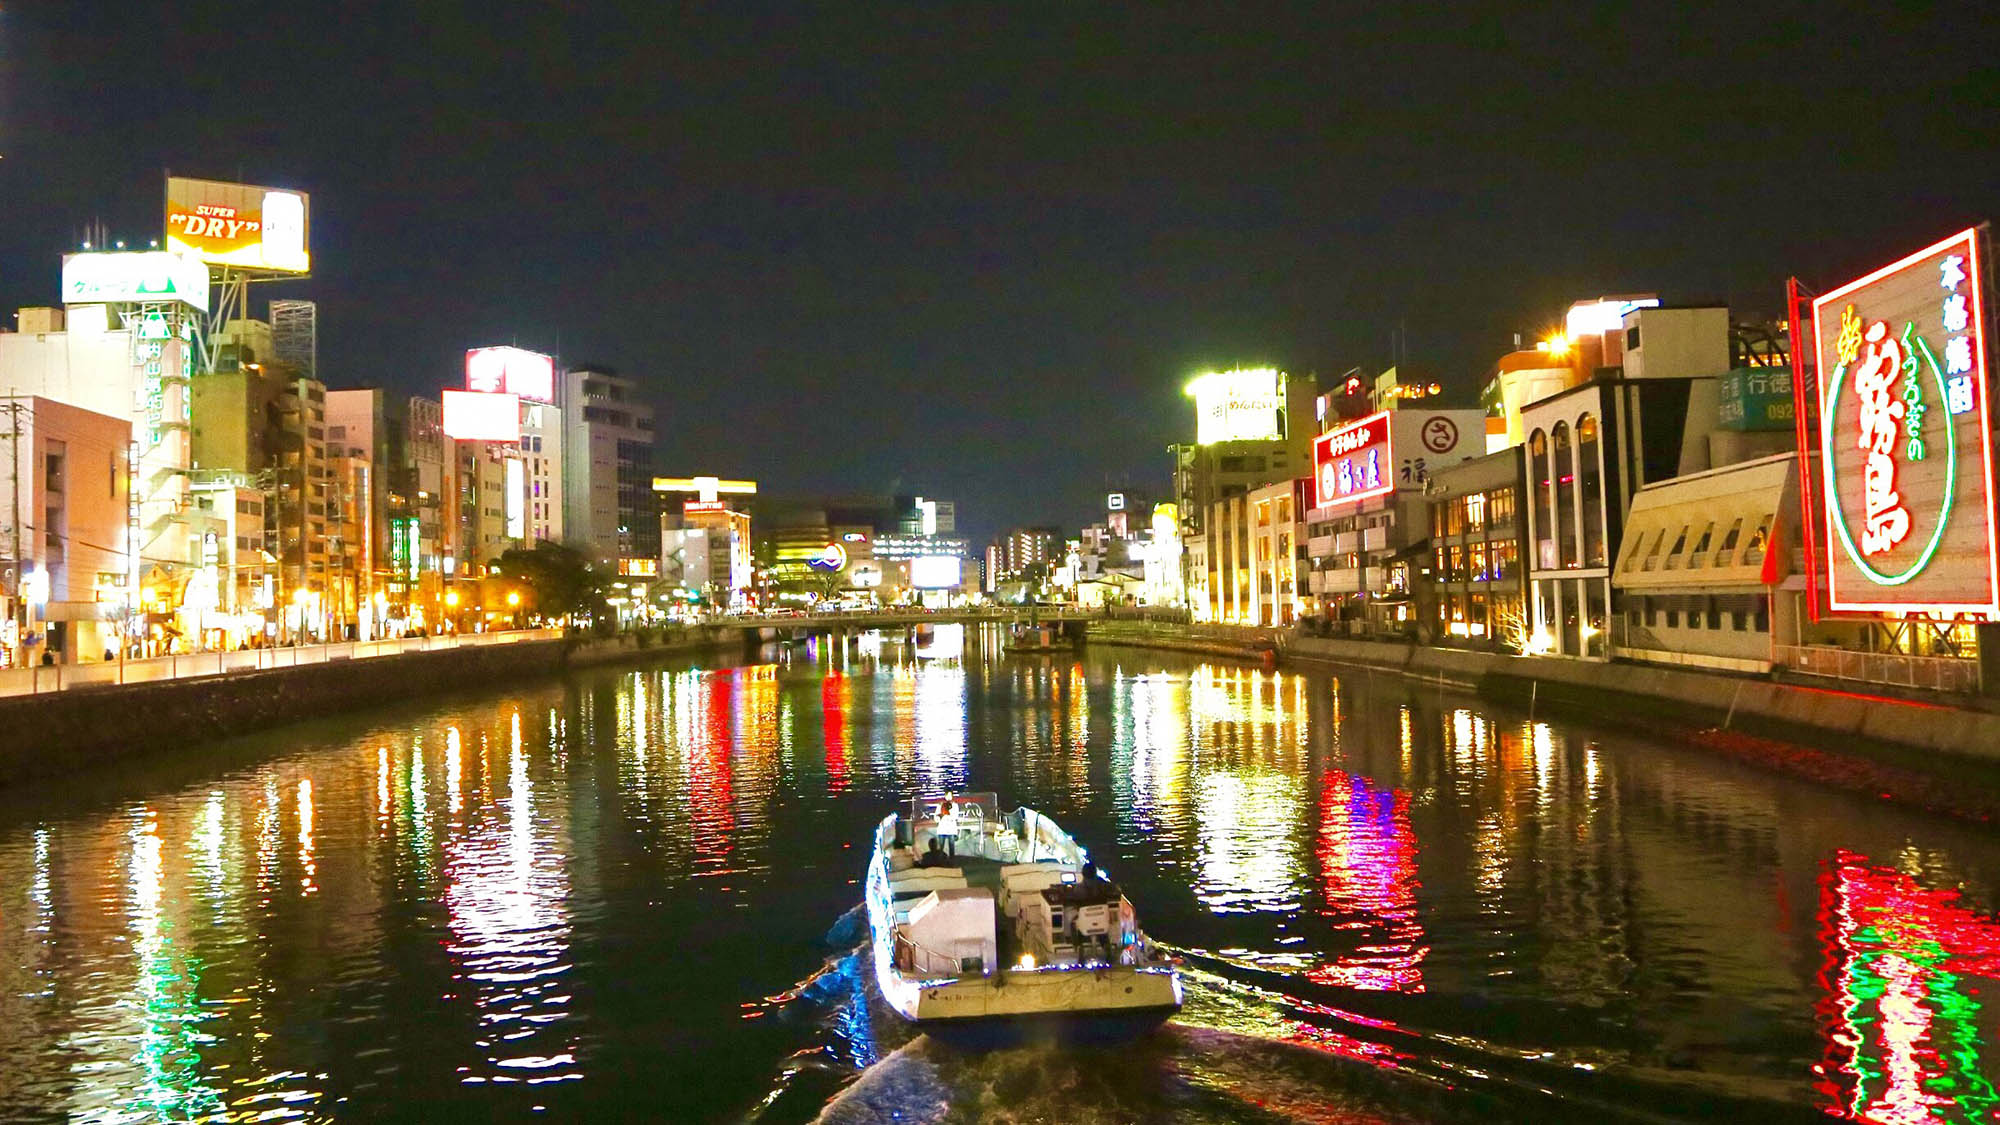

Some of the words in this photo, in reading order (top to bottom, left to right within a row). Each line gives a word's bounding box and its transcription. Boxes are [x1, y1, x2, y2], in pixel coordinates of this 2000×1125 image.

[196, 205, 236, 218] SUPER
[1940, 255, 1974, 414] 本格焼酎
